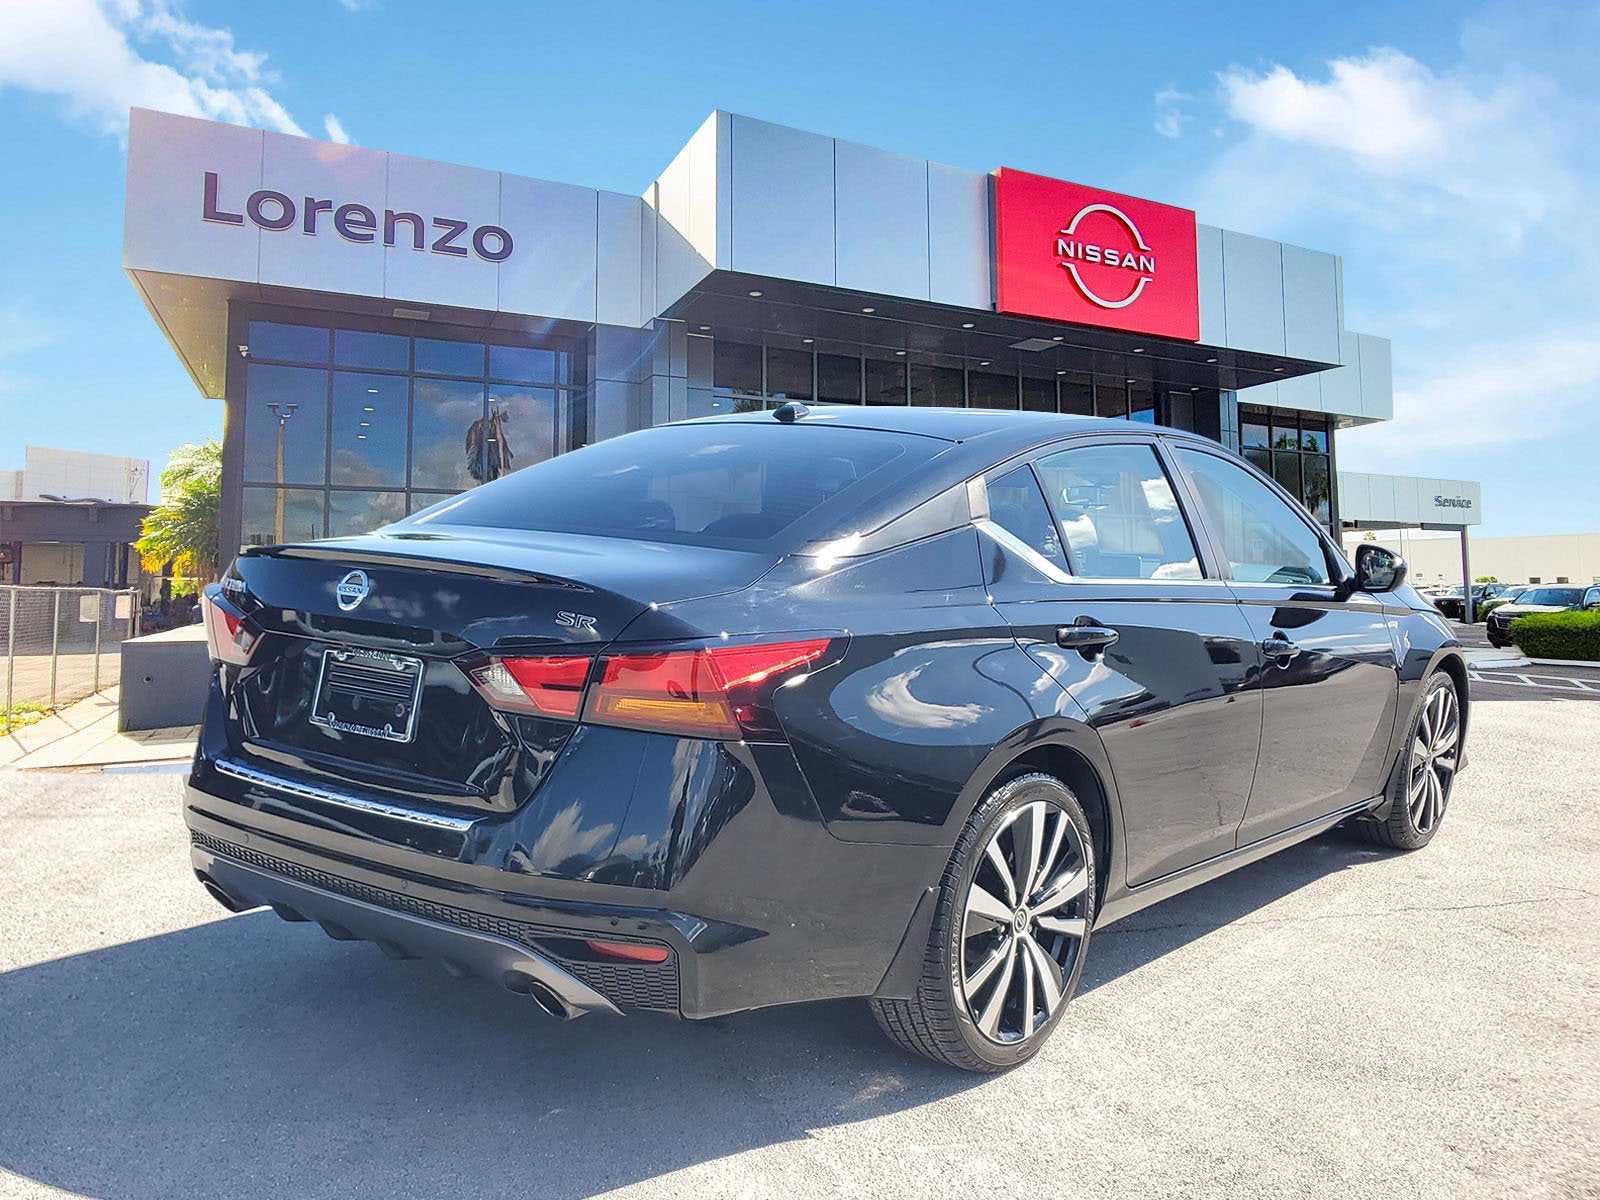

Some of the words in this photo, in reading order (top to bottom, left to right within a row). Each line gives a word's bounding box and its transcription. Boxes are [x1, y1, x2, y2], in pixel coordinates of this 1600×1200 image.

[202, 170, 514, 262] Lorenzo
[1057, 238, 1156, 273] NISSAN
[1434, 495, 1472, 509] Service
[555, 610, 597, 632] SR
